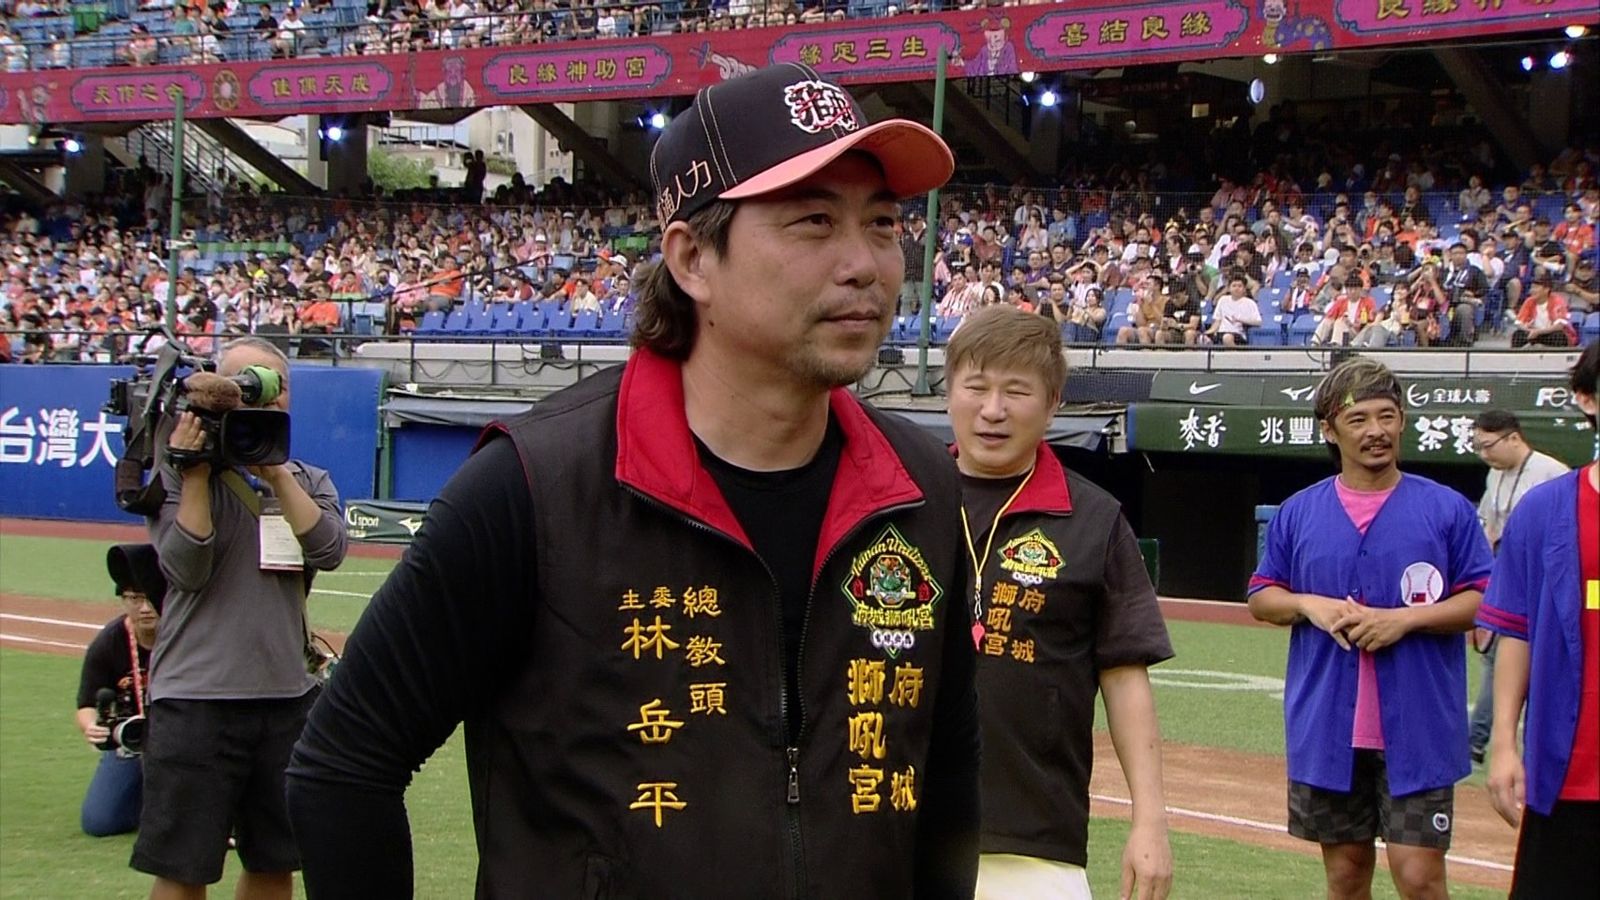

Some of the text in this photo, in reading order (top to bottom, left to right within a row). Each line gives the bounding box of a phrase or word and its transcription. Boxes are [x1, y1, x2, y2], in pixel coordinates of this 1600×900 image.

[1060, 11, 1211, 47] 喜結良緣
[509, 57, 646, 85] 良緣神助宮
[799, 36, 928, 65] 緣定三生
[1433, 388, 1491, 404] 全球人壽
[0, 406, 122, 468] 台灣大
[1179, 408, 1226, 450] 麥香
[1259, 416, 1326, 445] 兆豐
[618, 586, 677, 611] 主委
[852, 602, 935, 630] 府城獅吼宮
[984, 581, 1019, 657] 獅吼宮
[1011, 588, 1047, 664] 府城
[682, 585, 727, 716] 總教頭
[621, 614, 689, 829] 林岳平
[847, 658, 887, 815] 獅吼宮
[888, 661, 924, 811] 府城
